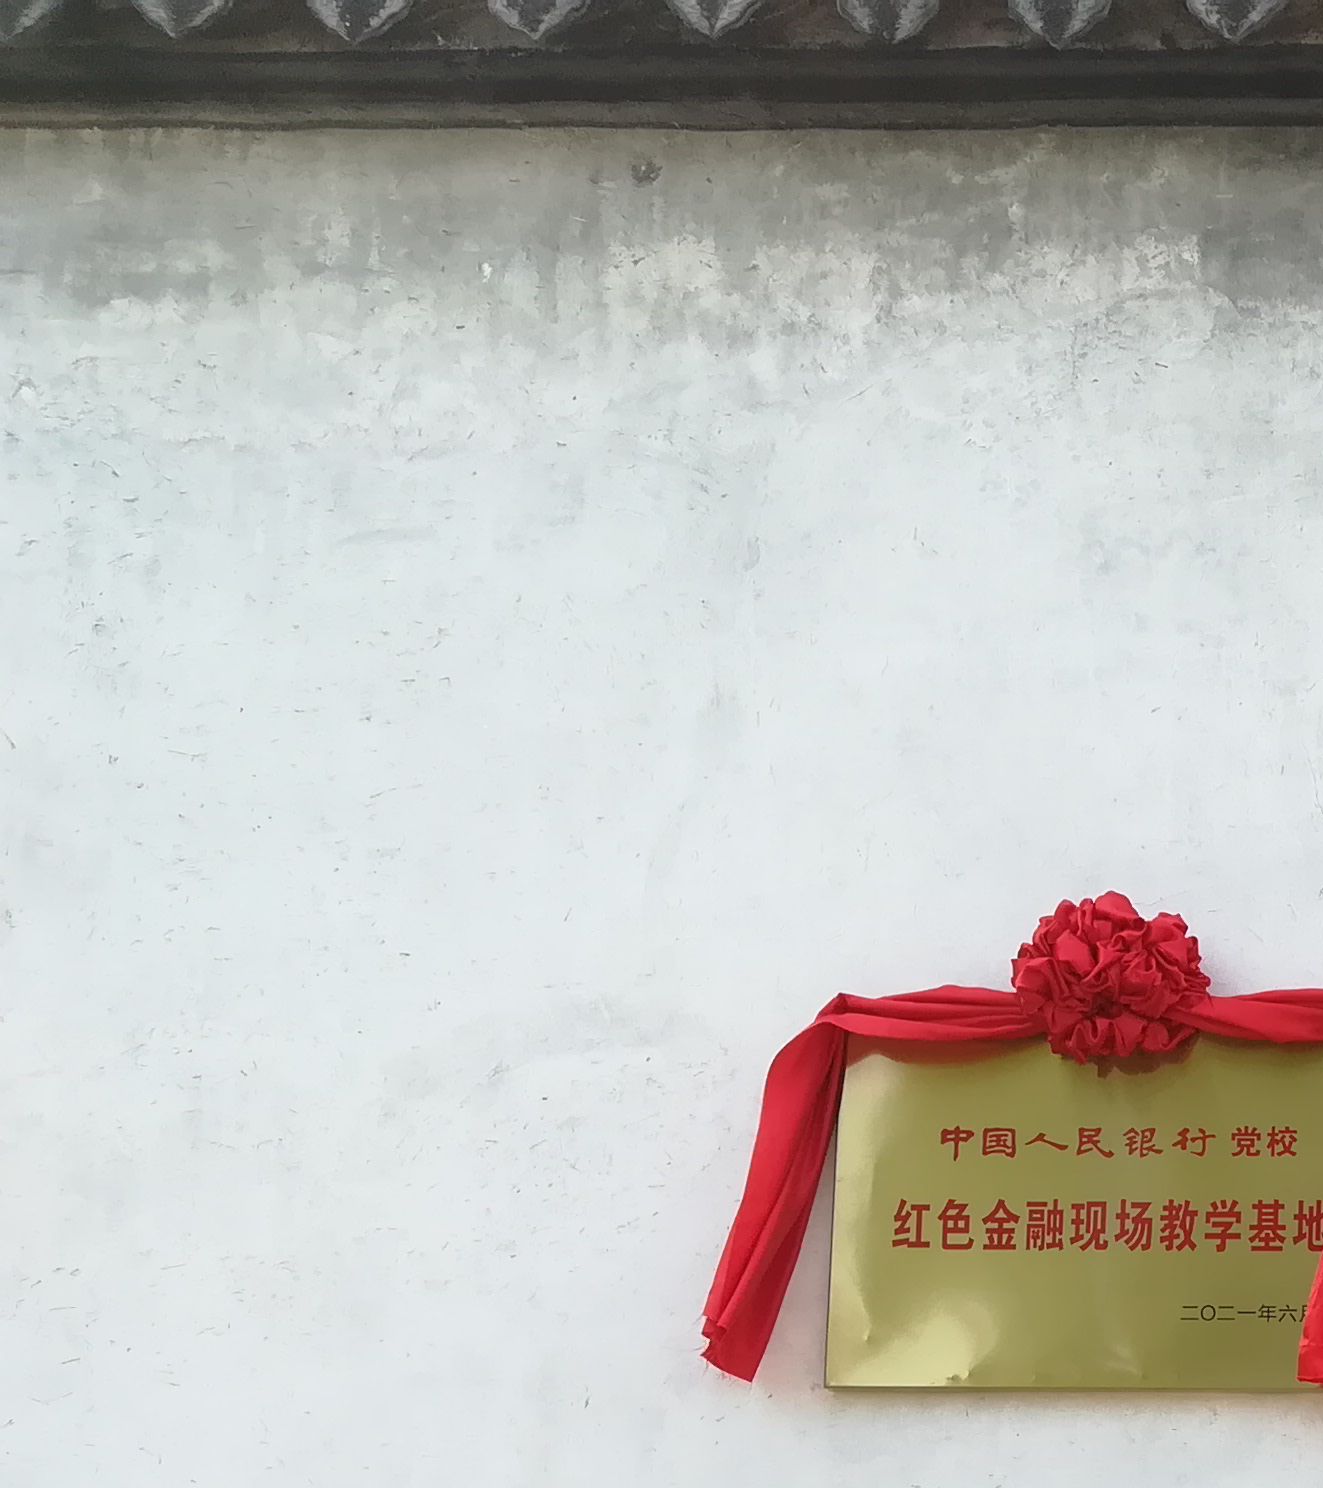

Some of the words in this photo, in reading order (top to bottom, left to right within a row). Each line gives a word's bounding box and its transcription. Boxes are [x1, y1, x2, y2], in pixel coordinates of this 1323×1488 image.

[940, 1126, 1299, 1161] 中国人民银行党校
